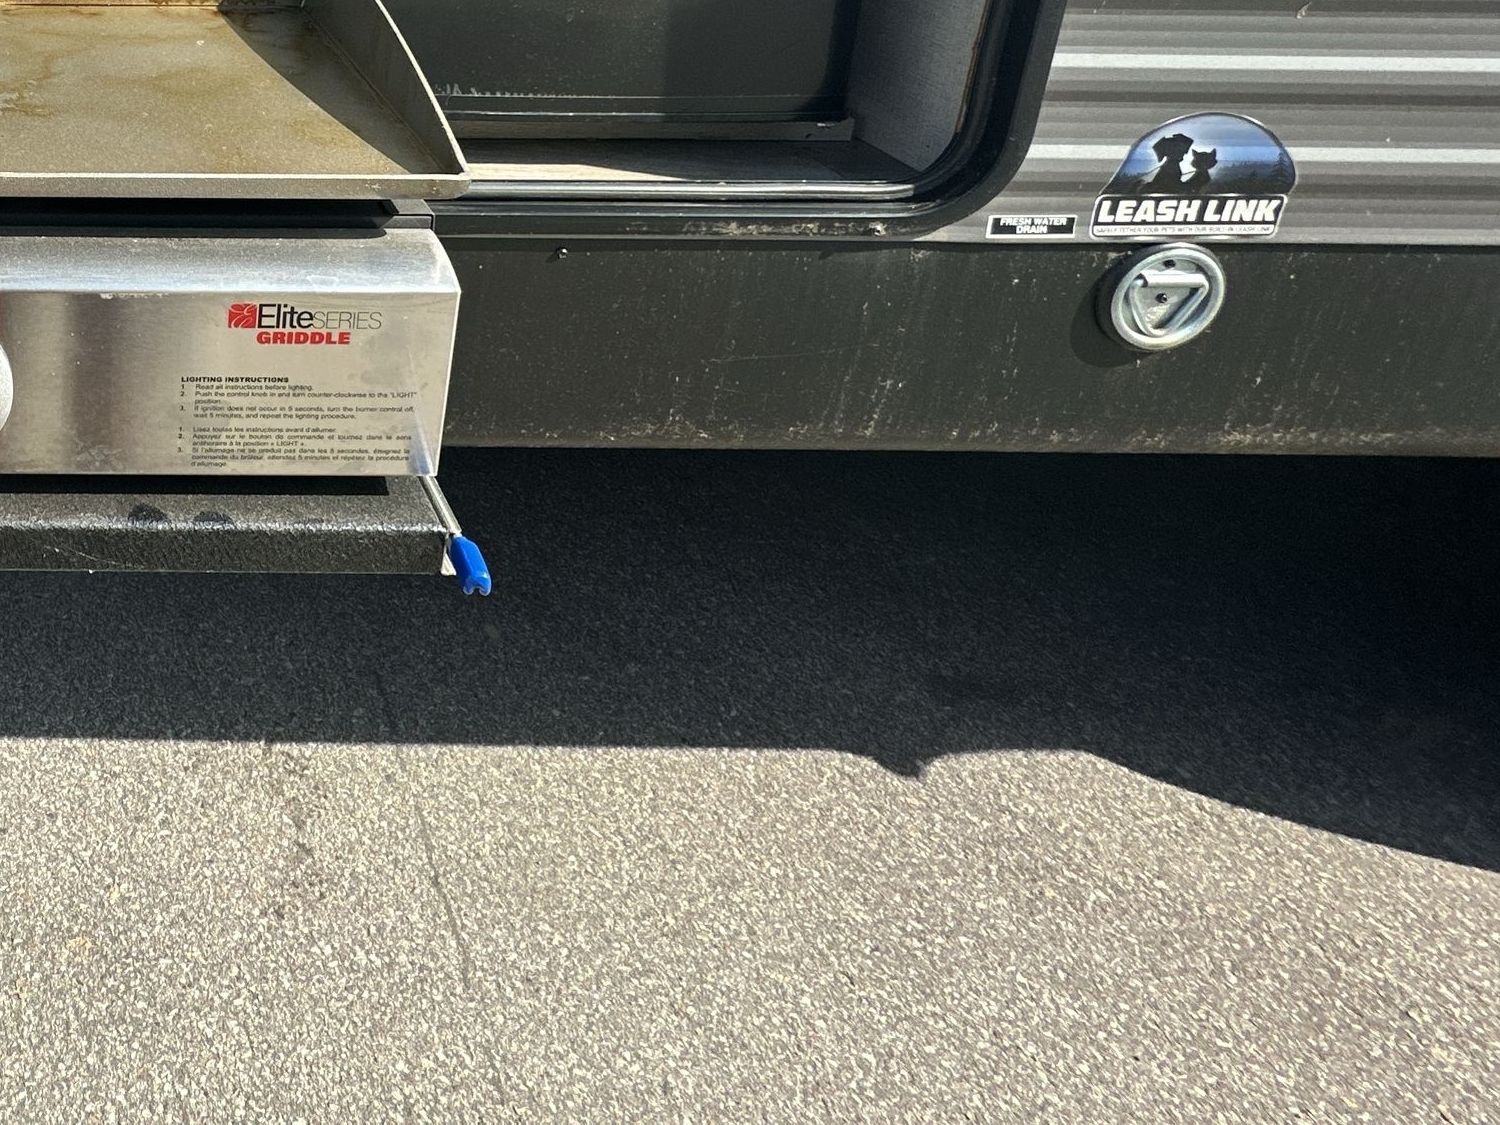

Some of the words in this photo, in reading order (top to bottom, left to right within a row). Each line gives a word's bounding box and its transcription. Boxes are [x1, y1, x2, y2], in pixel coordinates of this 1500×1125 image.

[1097, 200, 1202, 222] LEASH
[1203, 200, 1281, 222] LINK
[1000, 218, 1032, 226] FRESH
[1016, 226, 1048, 234] DRAIN
[256, 331, 351, 345] GRIDDLE
